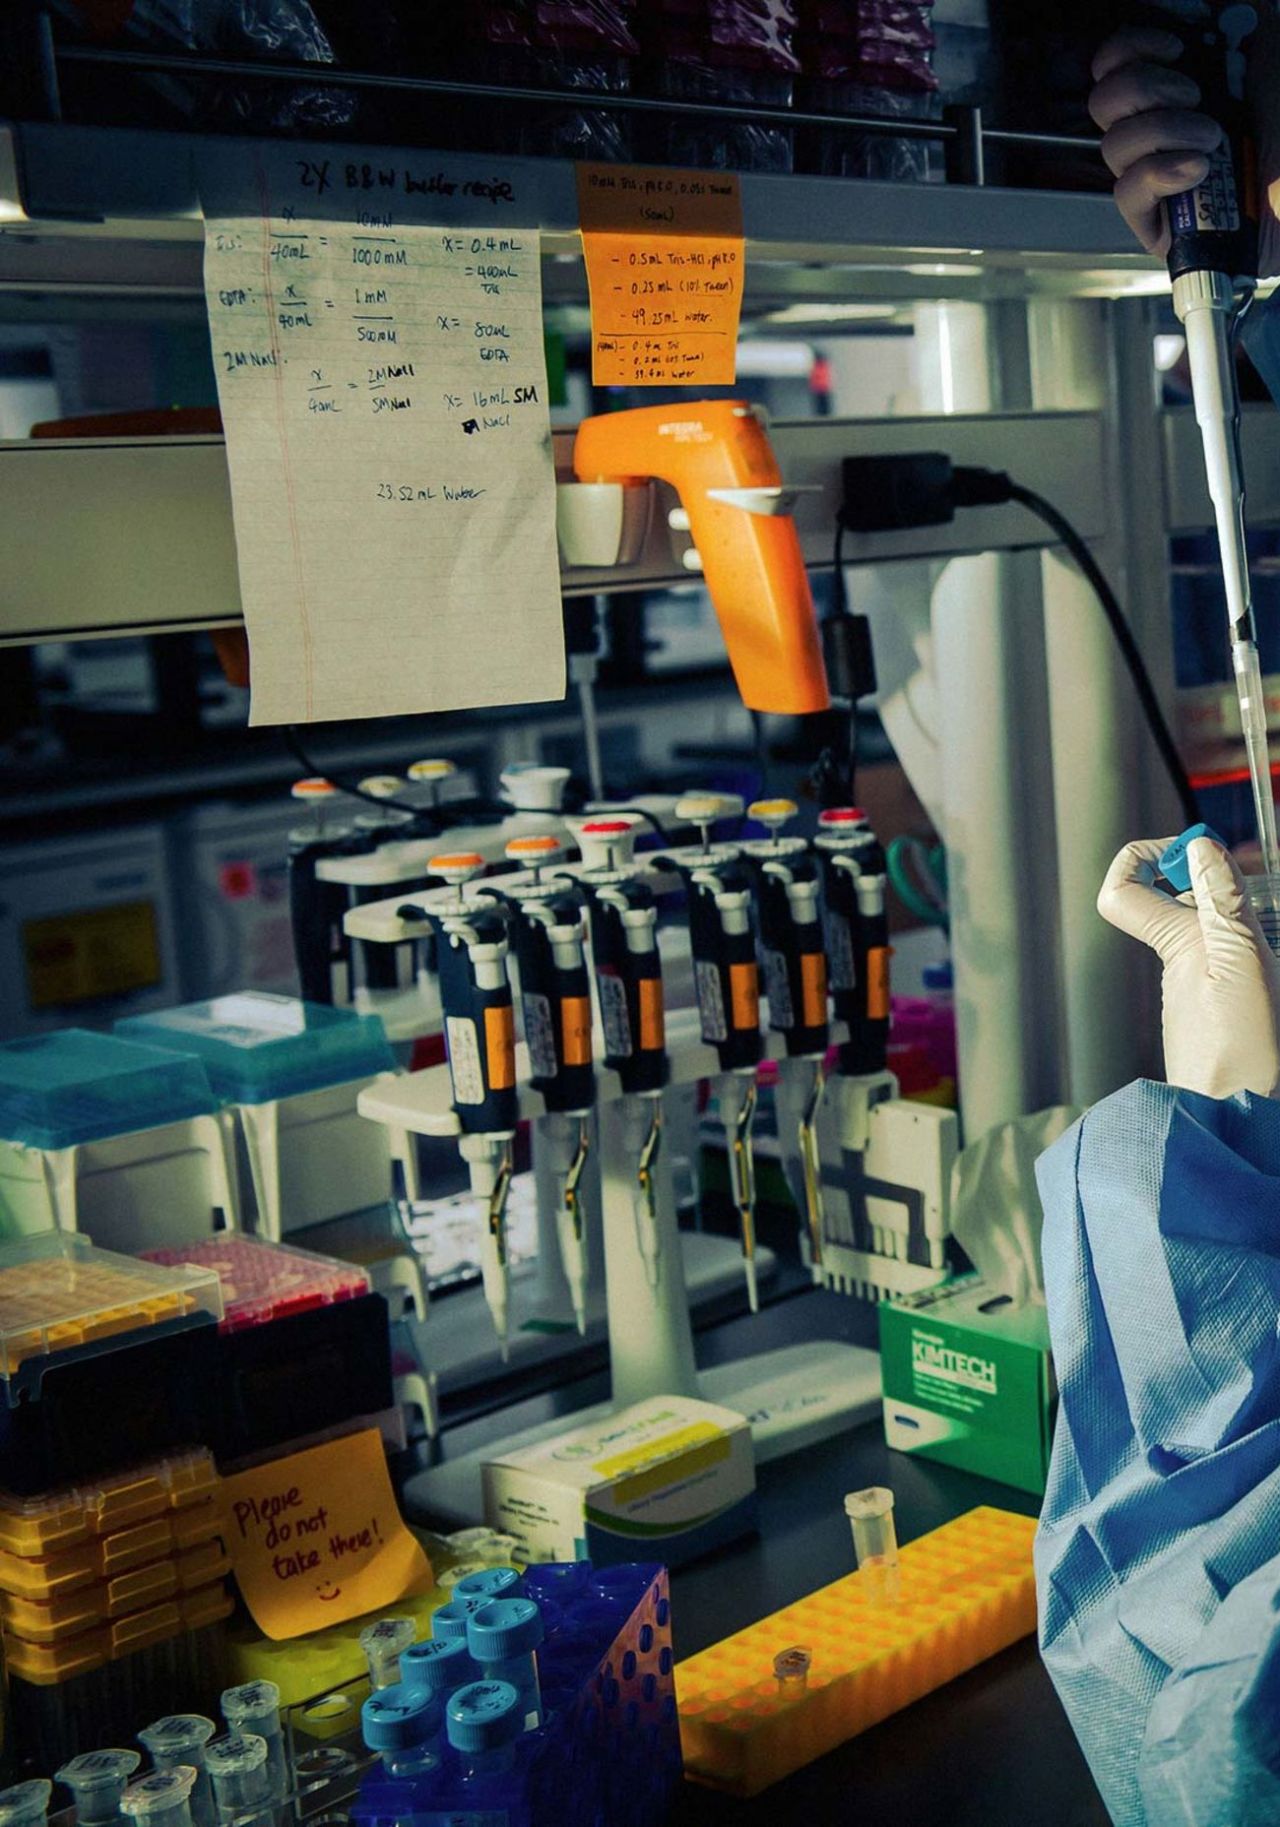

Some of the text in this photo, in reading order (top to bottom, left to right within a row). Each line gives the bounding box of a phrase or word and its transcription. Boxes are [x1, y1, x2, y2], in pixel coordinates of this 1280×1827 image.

[480, 347, 510, 362] EDTA
[911, 1338, 997, 1384] KIMTECH
[232, 1486, 304, 1538] Please
[265, 1506, 328, 1550] do not
[271, 1549, 321, 1580] take
